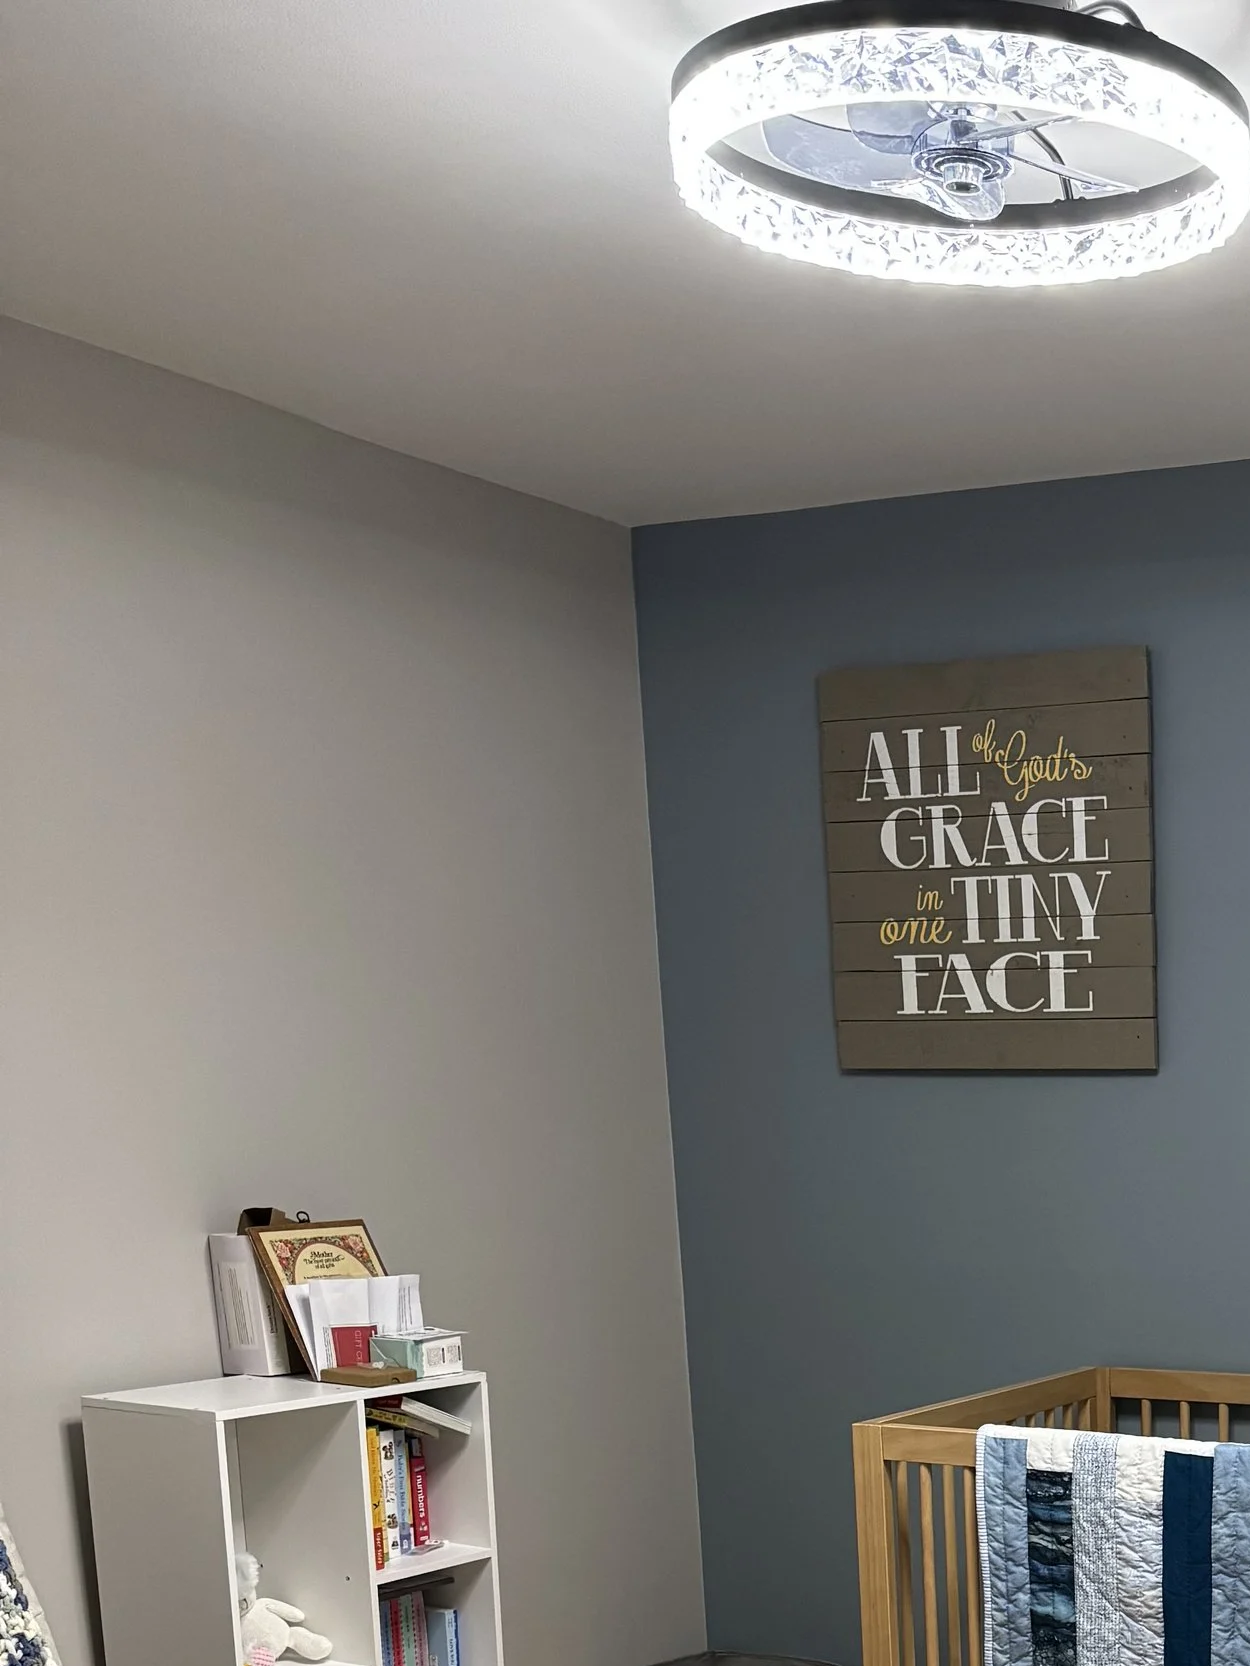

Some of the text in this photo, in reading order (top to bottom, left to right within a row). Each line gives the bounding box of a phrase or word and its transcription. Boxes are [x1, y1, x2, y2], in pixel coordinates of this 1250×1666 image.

[856, 718, 1093, 802] ALL of God's
[880, 795, 1110, 869] GRACE
[880, 870, 1112, 945] one TINY
[916, 884, 944, 911] in
[893, 949, 1094, 1015] FACE
[416, 1474, 426, 1518] numbers
